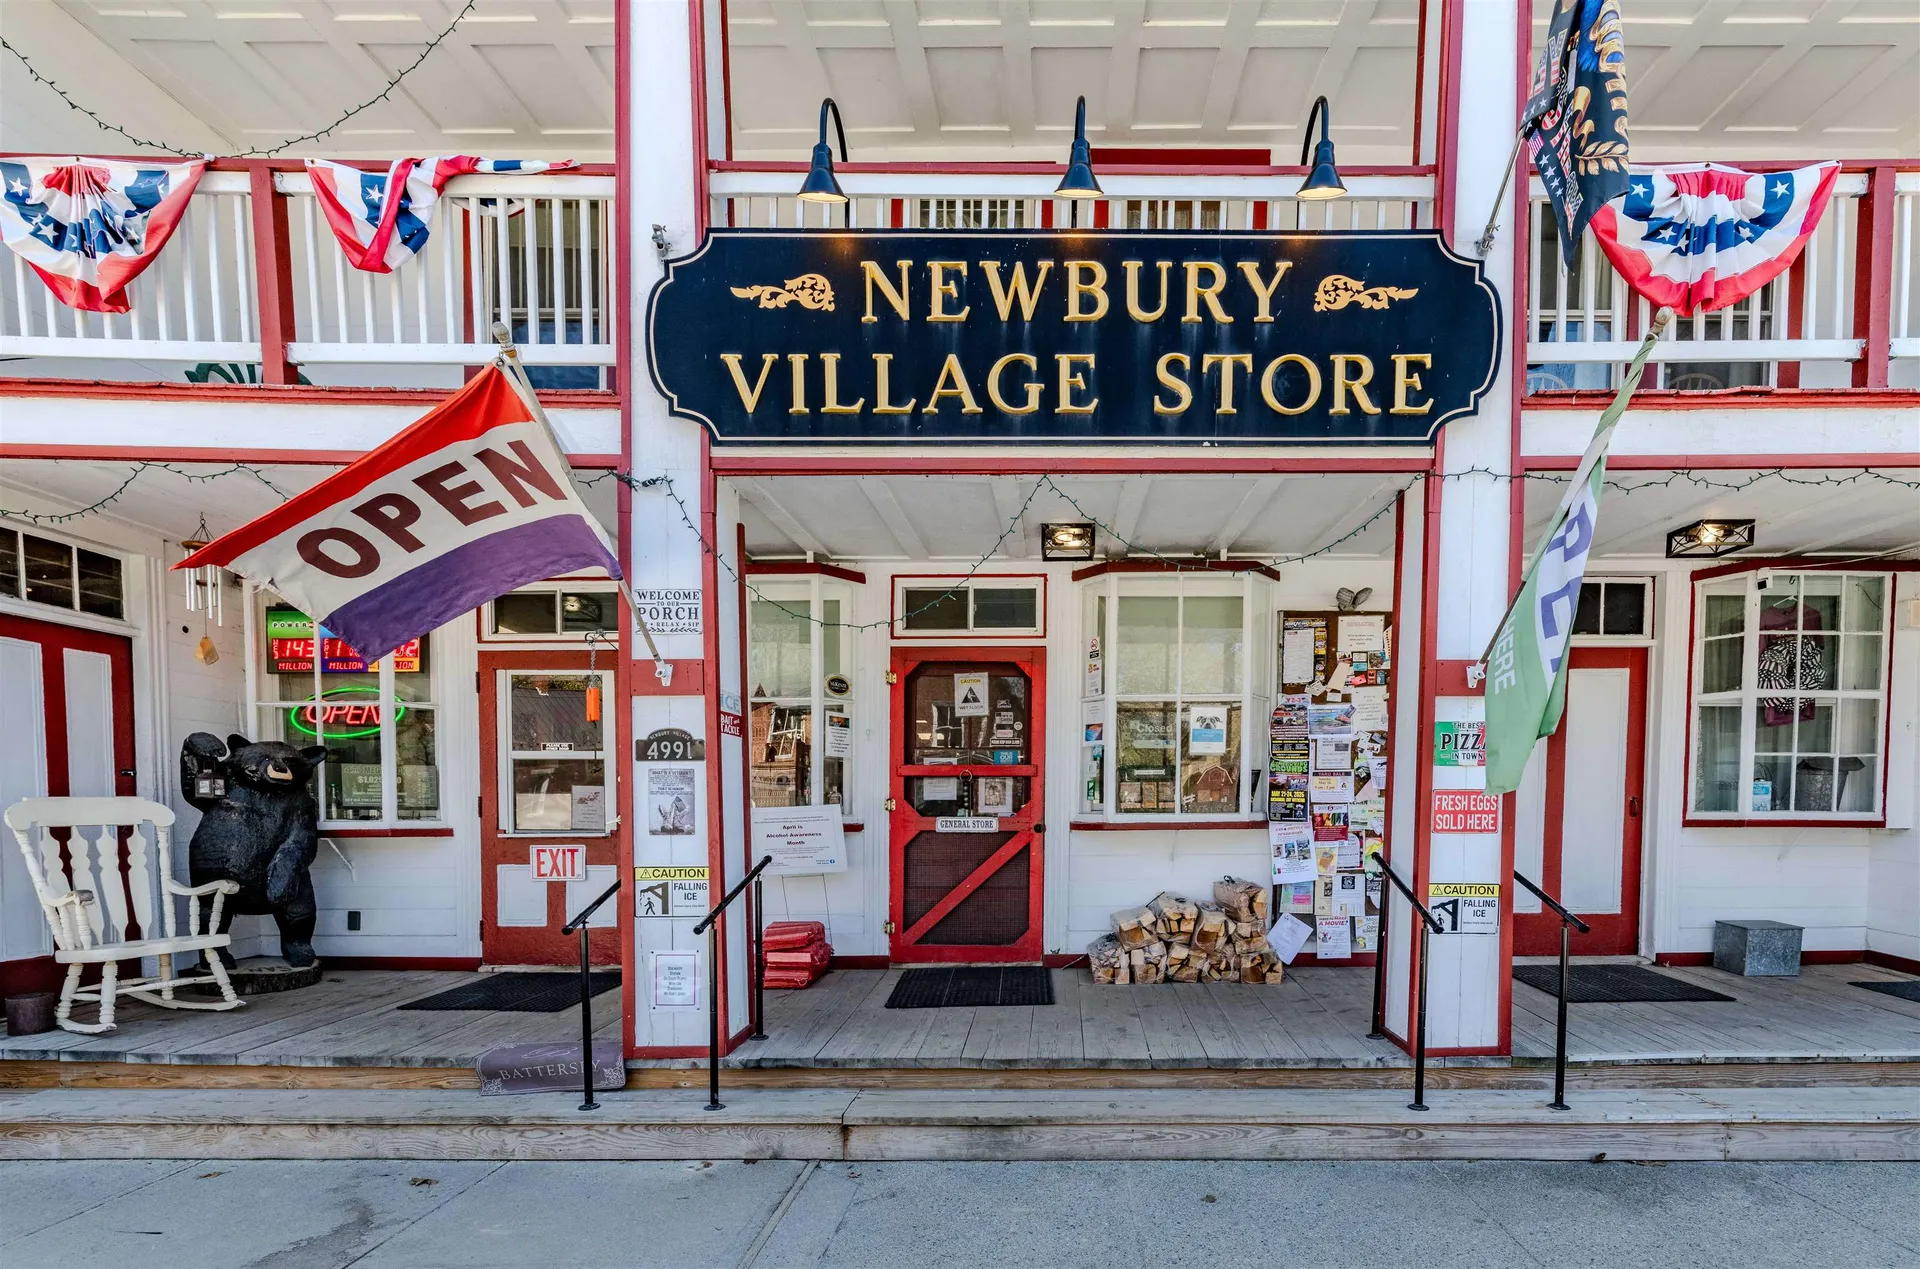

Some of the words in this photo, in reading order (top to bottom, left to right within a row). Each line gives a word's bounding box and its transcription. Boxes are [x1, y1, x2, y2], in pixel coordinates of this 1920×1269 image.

[860, 259, 1293, 324] NEWBURY
[719, 353, 1099, 415] VILLAGE
[1153, 353, 1434, 415] STORE
[296, 439, 568, 579] OPEN
[637, 590, 700, 601] WELCOME
[637, 606, 700, 620] PORCH
[278, 662, 312, 670] MILLION
[328, 662, 363, 670] MILLION
[306, 699, 381, 724] OPEN
[720, 714, 734, 726] BAIT
[720, 724, 740, 736] TACKLE
[1137, 723, 1173, 733] Closed
[650, 730, 670, 740] NEWBURY
[673, 730, 690, 740] VILLAGE
[1440, 733, 1486, 751] PIZZ
[646, 741, 692, 760] 4991
[1435, 794, 1468, 811] FRESH
[1470, 795, 1497, 811] EGGS
[940, 820, 971, 829] GENERAL
[972, 820, 994, 829] STORE
[1435, 814, 1465, 830] SOLD
[1466, 814, 1496, 830] HERE
[536, 848, 579, 878] EXIT
[652, 868, 705, 878] CAUTION
[673, 882, 708, 891] FALLING
[1444, 885, 1495, 895] CAUTION
[684, 892, 697, 900] ICE
[1464, 900, 1496, 908] FALLING
